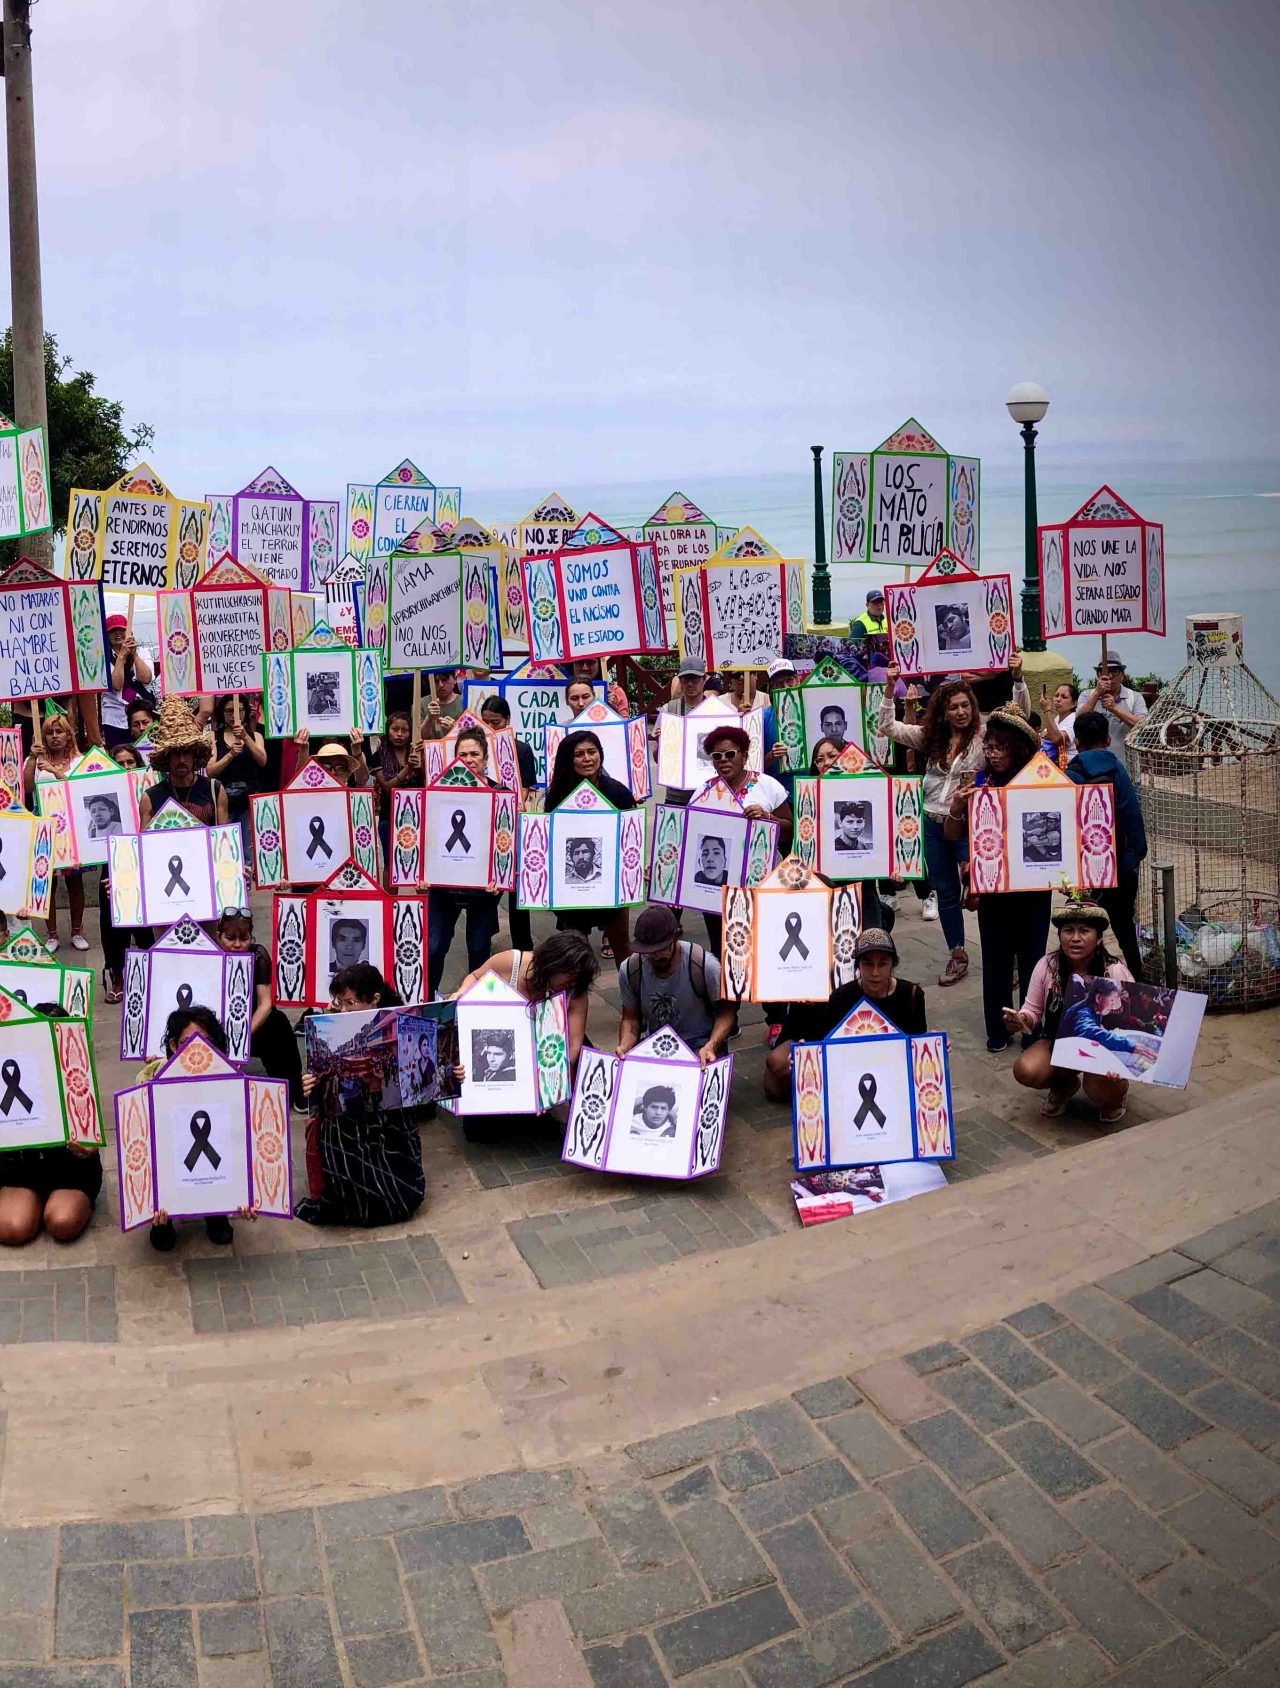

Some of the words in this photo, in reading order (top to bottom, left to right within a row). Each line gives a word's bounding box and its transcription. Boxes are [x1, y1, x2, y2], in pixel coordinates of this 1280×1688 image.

[885, 462, 921, 490] LOS
[111, 500, 147, 516] ANTES
[152, 504, 167, 518] DE
[384, 494, 429, 512] CIERREN
[879, 482, 933, 522] MATÓ
[251, 504, 292, 522] QATUN
[105, 516, 168, 538] RENDIRNOS
[241, 522, 301, 537] MANCHAKUY
[395, 517, 408, 534] EL
[694, 529, 706, 539] LA
[241, 539, 253, 550] EL
[261, 538, 299, 551] TERROR
[525, 527, 551, 545] NO
[552, 528, 565, 545] SE
[873, 522, 890, 554] LA
[110, 540, 167, 559] SEREMOS
[677, 545, 688, 555] DE
[692, 543, 709, 555] LOS
[1074, 540, 1097, 557] NOS
[1101, 540, 1120, 555] UNE
[1125, 540, 1137, 554] LA
[251, 552, 284, 565] VIENE
[100, 559, 168, 588] ETERNOS
[566, 559, 609, 584] SOMOS
[1104, 561, 1128, 577] NOS
[729, 569, 750, 590] LO
[20, 588, 60, 611] MATARÁS
[567, 587, 588, 602] UNO
[591, 583, 621, 598] CONTRA
[1075, 586, 1105, 601] SEPARA
[1106, 586, 1115, 600] EL
[1115, 584, 1141, 600] ESTADO
[714, 583, 780, 621] VIMOS
[9, 615, 25, 634] NI
[29, 612, 53, 630] CON
[569, 608, 581, 624] EL
[1075, 608, 1109, 626] CUANDO
[1111, 608, 1133, 623] MATA
[421, 624, 447, 641] NOS
[573, 632, 585, 647] DE
[587, 629, 625, 644] ESTADO
[0, 632, 59, 659] HAMBRE
[201, 643, 264, 659] BROTAREMOS
[403, 640, 452, 658] CALLAN!
[14, 658, 31, 676] NI
[34, 656, 59, 674] CON
[202, 662, 220, 674] MIL
[222, 660, 256, 673] VECES
[9, 674, 61, 697] BALAS
[216, 673, 248, 689] MÁS!
[517, 690, 560, 708] CADA
